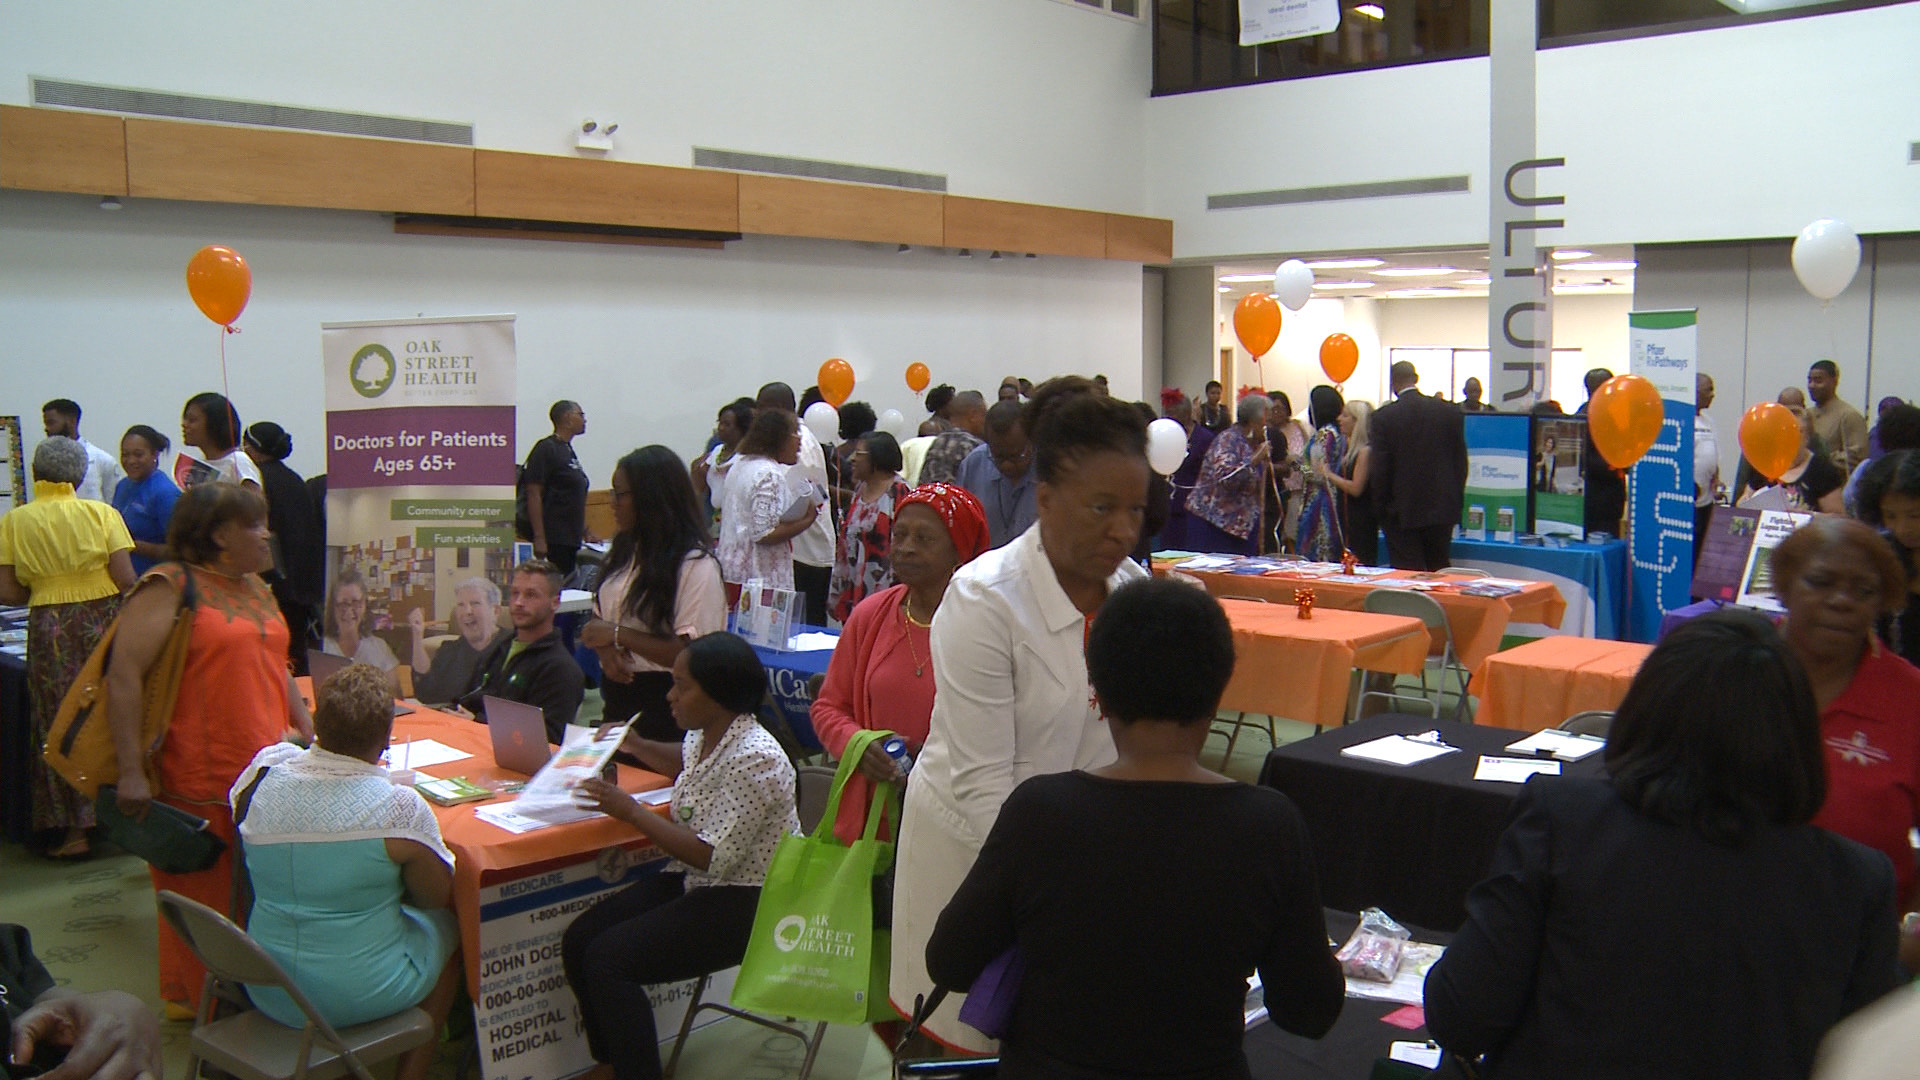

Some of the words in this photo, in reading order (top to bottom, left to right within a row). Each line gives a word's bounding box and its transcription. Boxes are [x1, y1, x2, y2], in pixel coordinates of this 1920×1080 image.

[405, 340, 442, 354] OAK
[404, 356, 474, 370] STREET
[404, 371, 478, 386] HEALTH
[333, 435, 395, 451] Doctors
[400, 430, 426, 447] for
[430, 430, 508, 447] Patients
[373, 456, 414, 477] Ages
[419, 455, 457, 471] 65+
[406, 505, 466, 518] Community
[468, 507, 502, 516] center
[433, 534, 454, 543] Fun
[455, 533, 502, 543] activities
[499, 872, 565, 898] MEDICARE
[800, 939, 856, 958] HEALTH
[482, 953, 525, 978] JOHN
[529, 942, 562, 964] DOE
[490, 1004, 534, 1025] ENTITLED
[536, 999, 549, 1010] TO
[489, 1008, 567, 1044] HOSPITAL
[492, 1029, 563, 1063] MEDICAL
